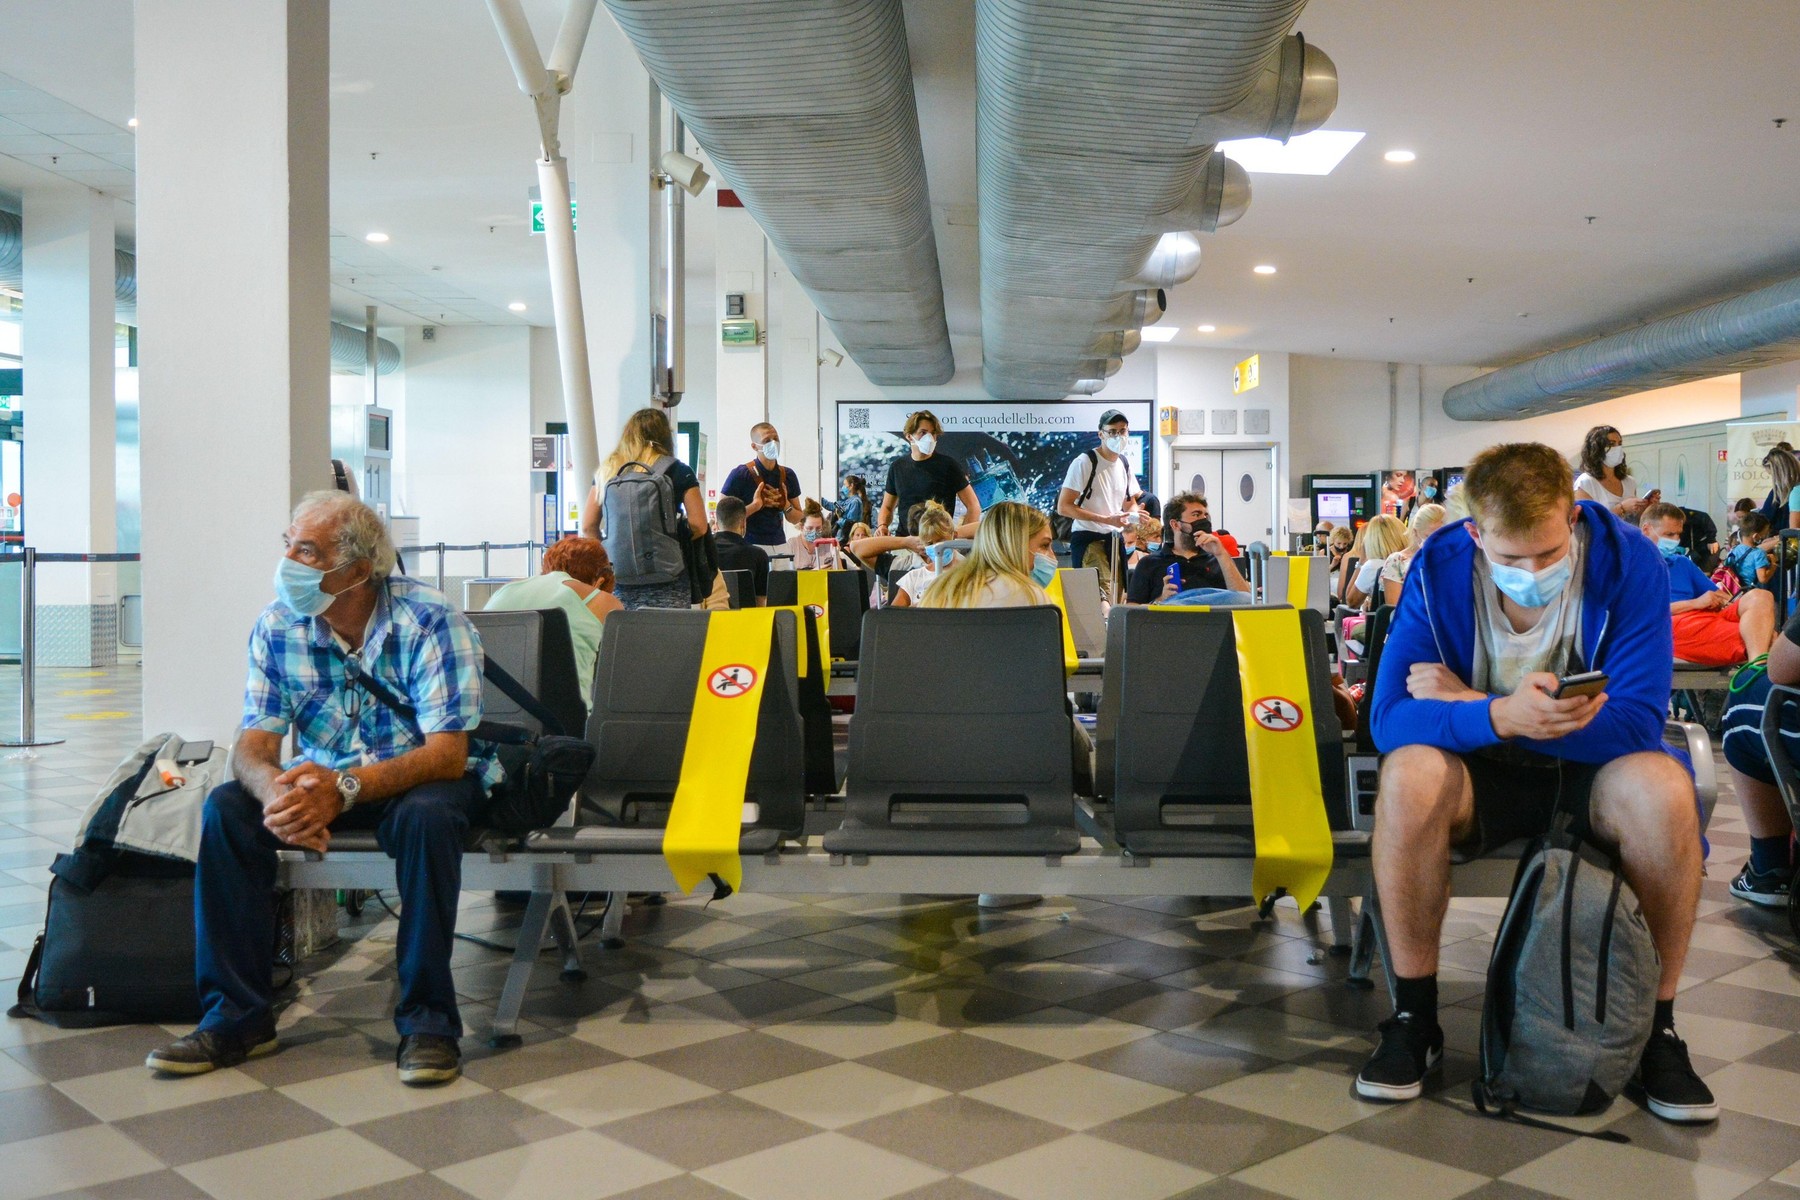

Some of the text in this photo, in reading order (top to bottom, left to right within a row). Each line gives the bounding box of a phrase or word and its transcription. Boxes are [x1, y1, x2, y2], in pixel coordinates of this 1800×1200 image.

[941, 412, 1076, 428] on acquadellelba.com
[1733, 470, 1770, 480] BOLG
